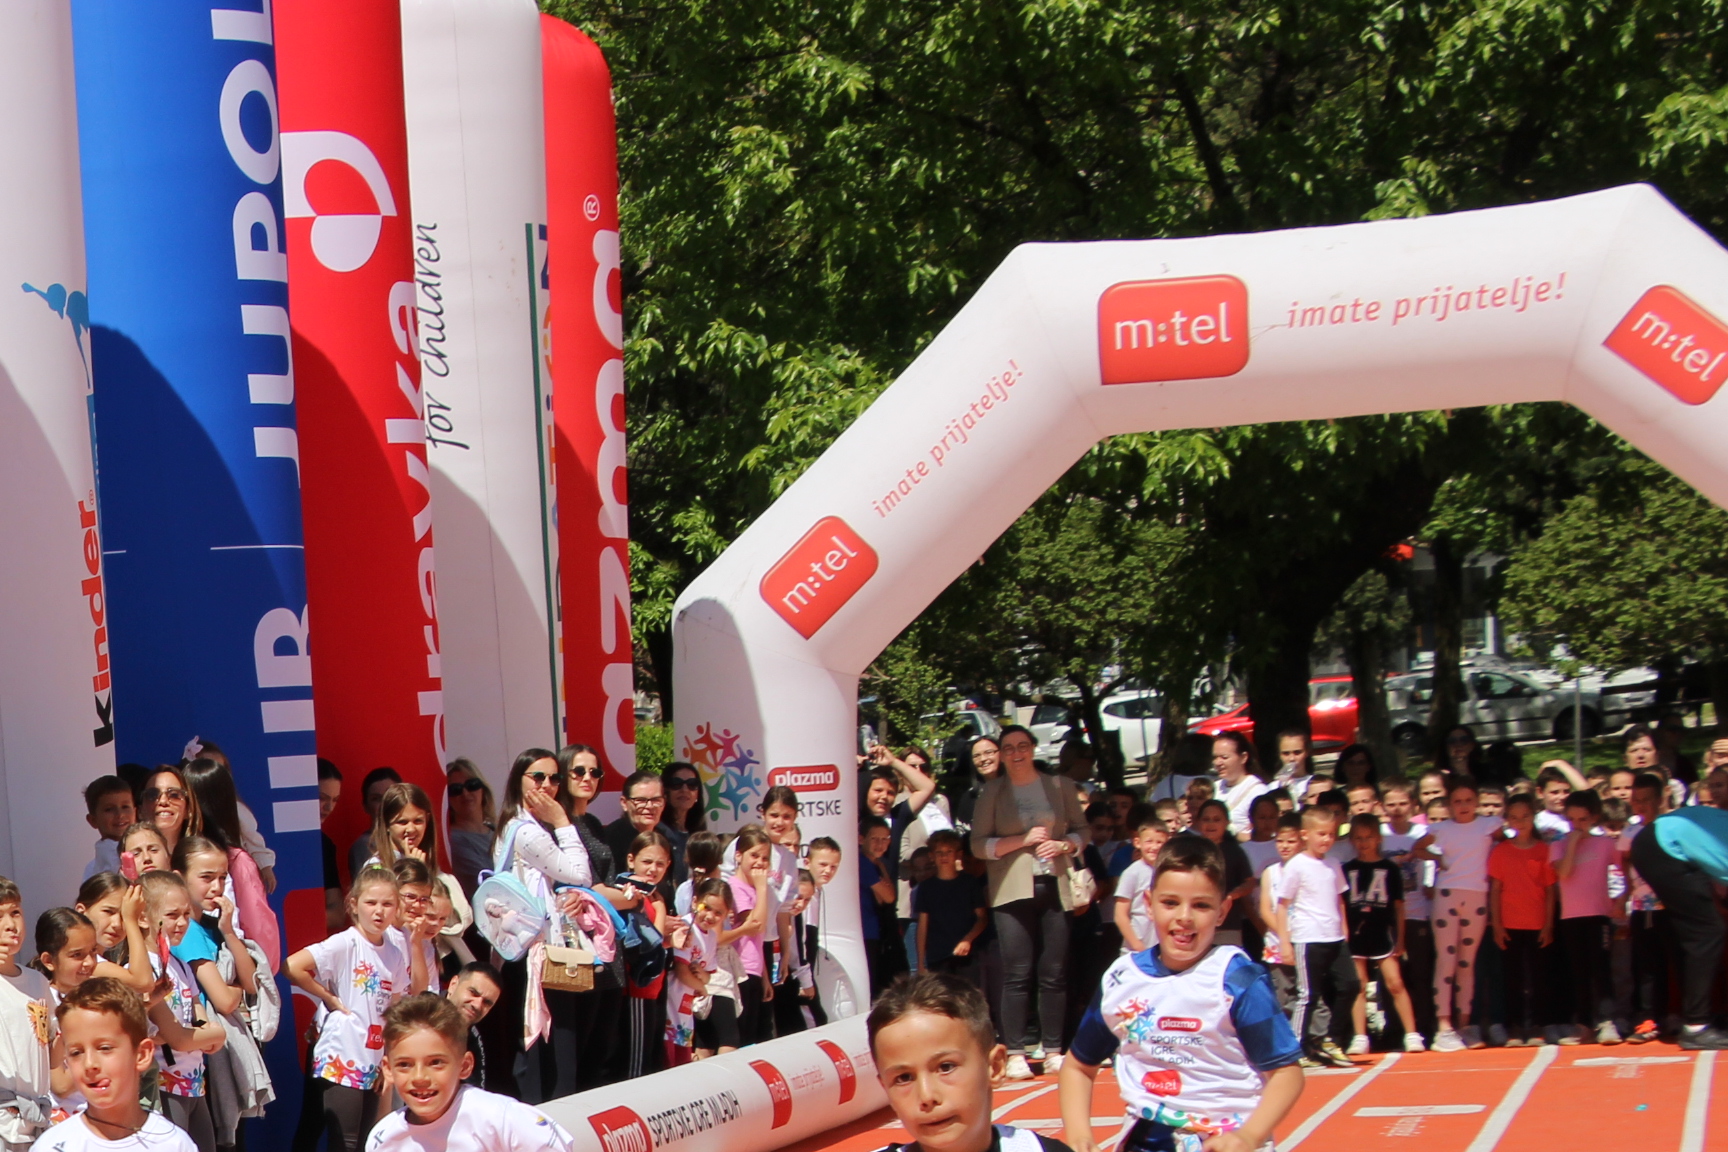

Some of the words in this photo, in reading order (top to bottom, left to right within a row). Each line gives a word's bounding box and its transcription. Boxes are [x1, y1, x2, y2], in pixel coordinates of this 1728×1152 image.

[414, 222, 450, 378] children
[1113, 301, 1233, 350] m:tel
[1287, 300, 1381, 329] imate
[1392, 272, 1567, 326] prijatelje!
[1631, 311, 1728, 381] m:tel
[872, 461, 930, 518] imate
[930, 359, 1024, 467] prijatelje!
[781, 535, 858, 613] m:tel
